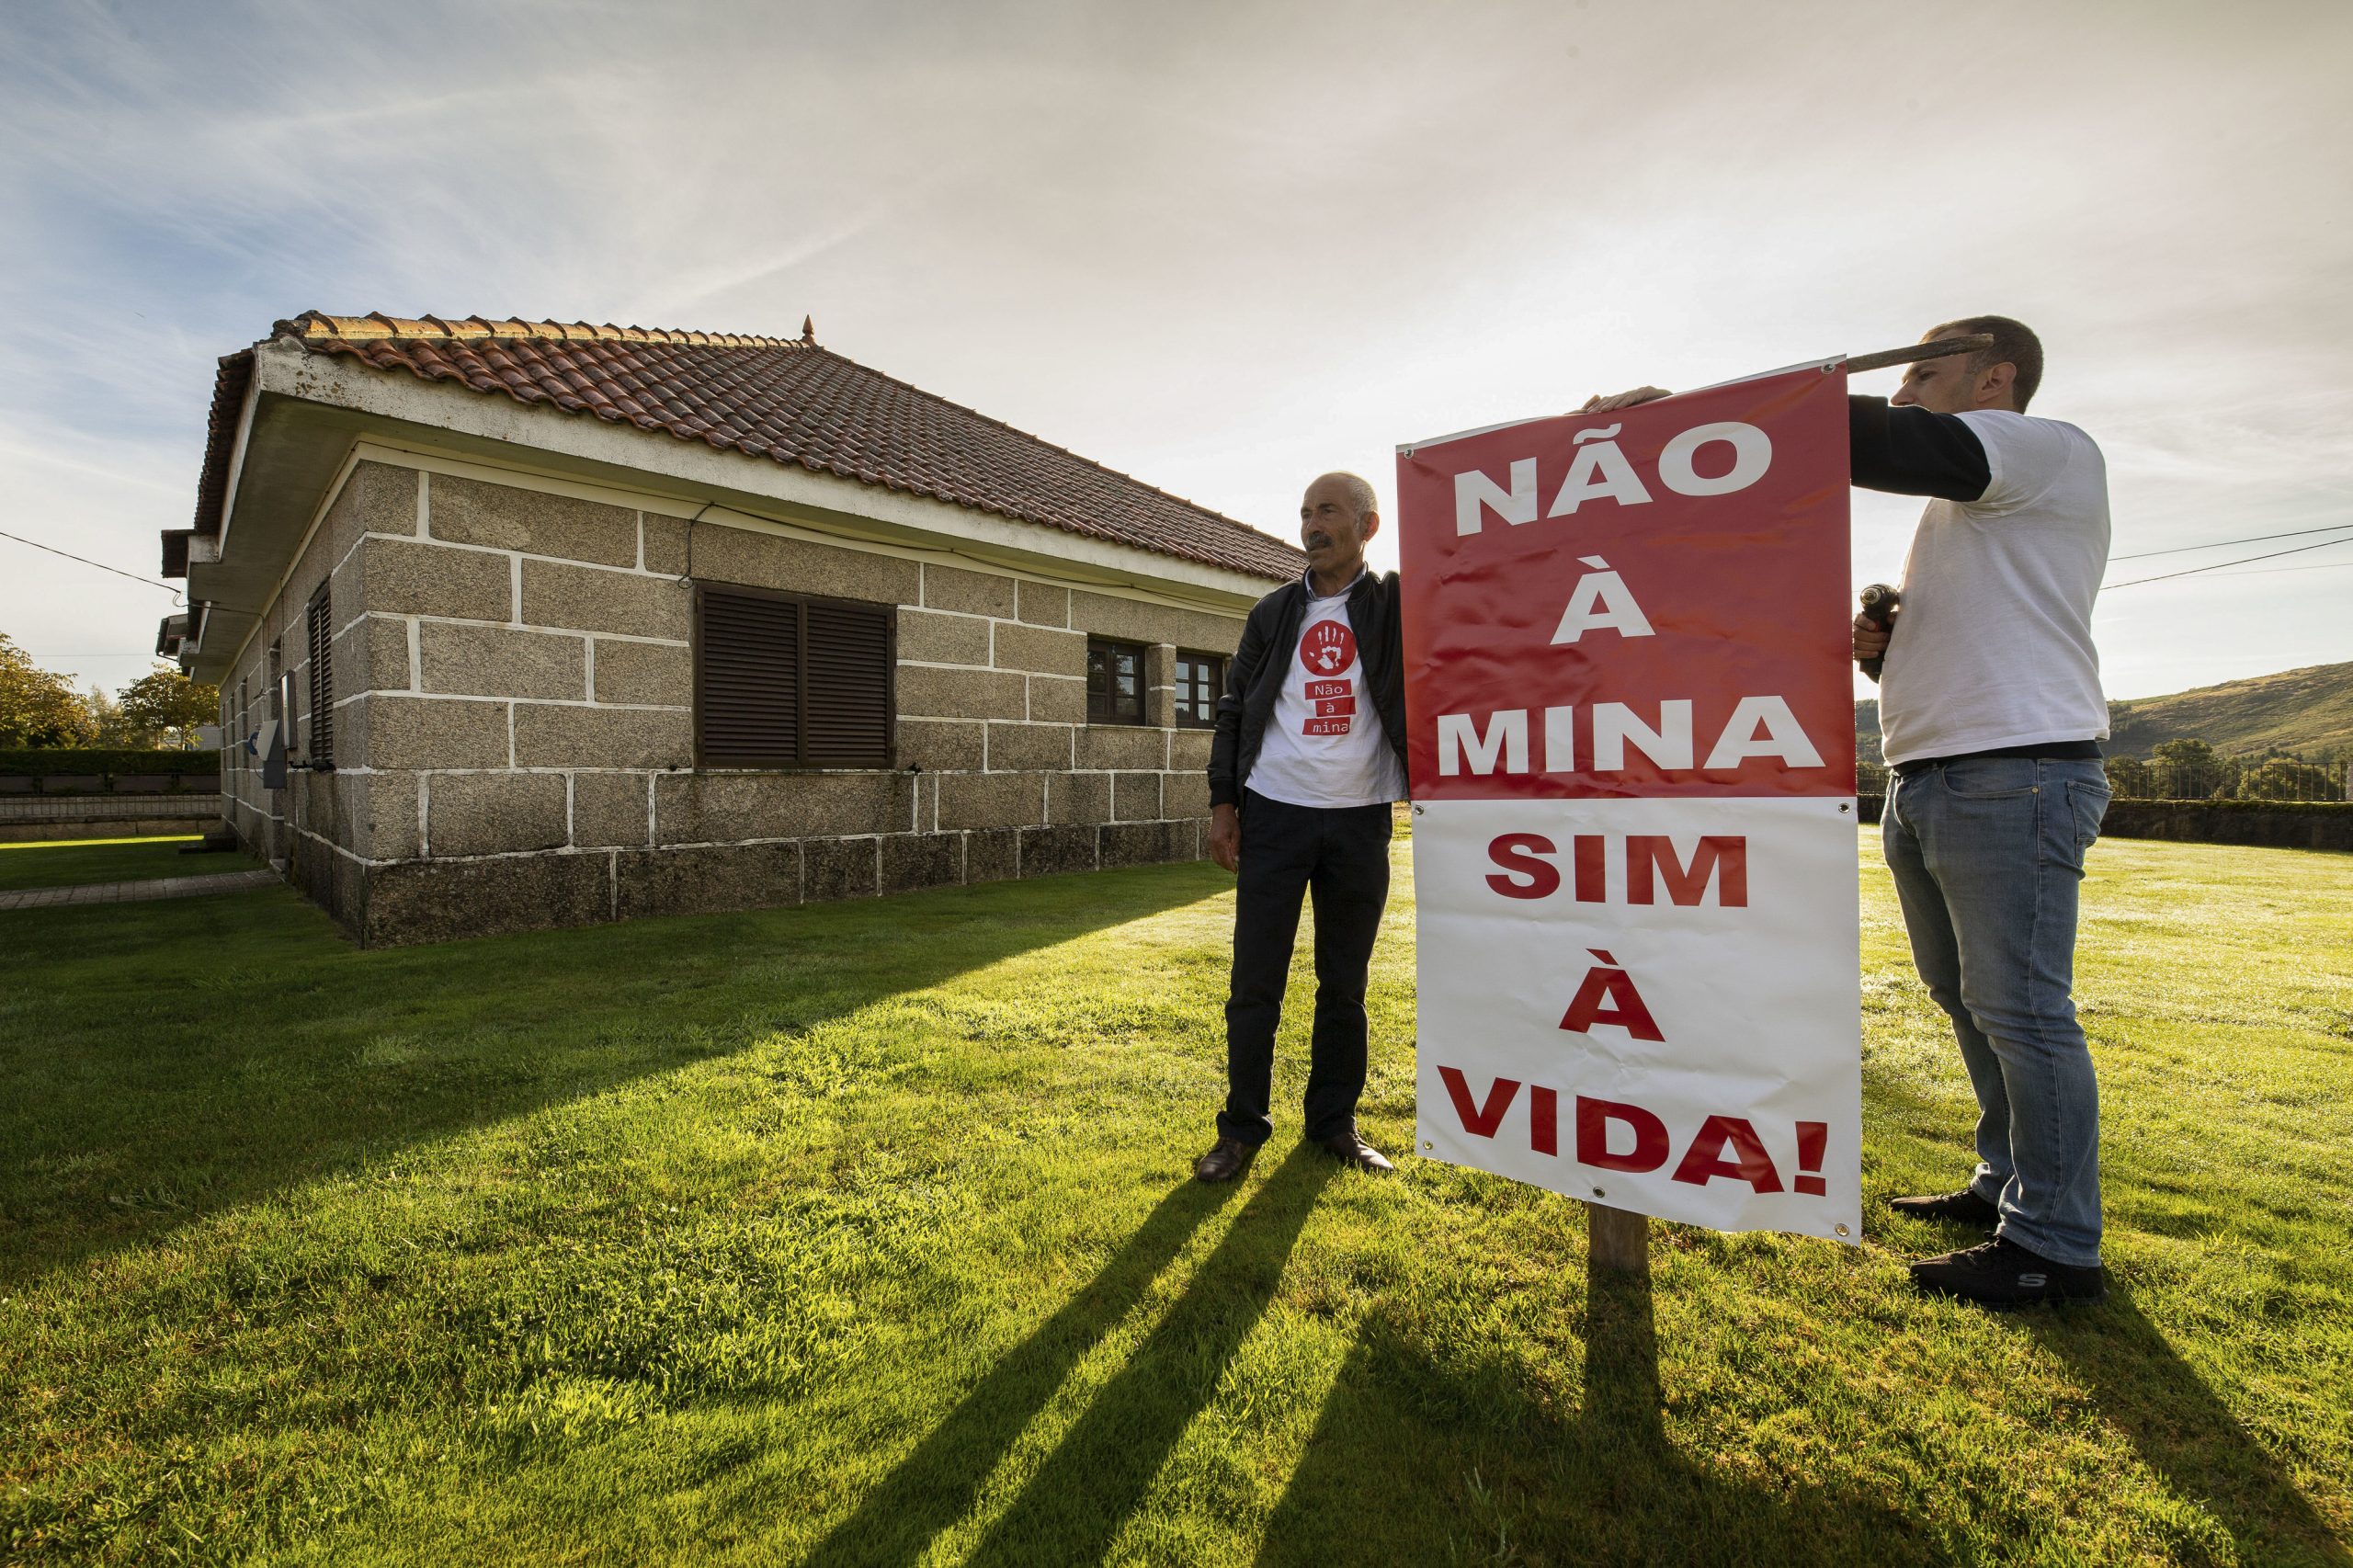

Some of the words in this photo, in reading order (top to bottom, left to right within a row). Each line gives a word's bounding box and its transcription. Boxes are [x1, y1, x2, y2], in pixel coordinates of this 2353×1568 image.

[1454, 421, 1773, 537] NÃO
[1550, 554, 1655, 644] À
[1313, 722, 1348, 733] mina
[1314, 684, 1343, 696] Não
[1326, 702, 1335, 713] à
[1437, 695, 1826, 777] MINA
[1484, 833, 1748, 907] SIM
[1558, 949, 1665, 1042] À
[1437, 1065, 1828, 1197] VIDA!
